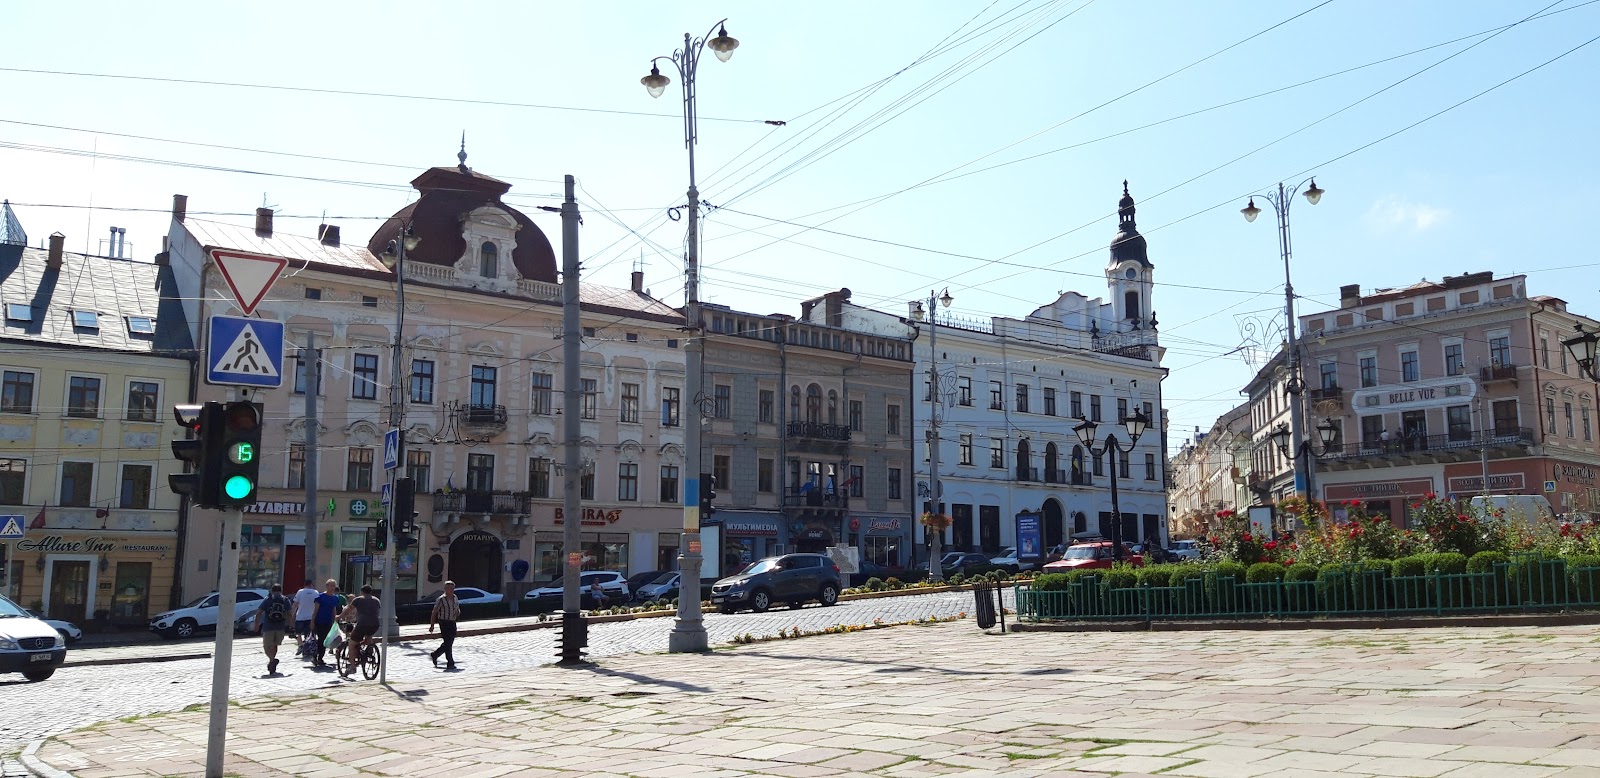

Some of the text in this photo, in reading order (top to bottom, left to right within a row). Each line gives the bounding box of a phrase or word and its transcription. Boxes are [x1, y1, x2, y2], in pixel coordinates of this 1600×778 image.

[1389, 388, 1436, 404] BELLE VUE
[237, 444, 252, 461] 15
[554, 507, 606, 521] BiRA
[17, 535, 82, 552] Allure
[85, 536, 117, 552] Inn
[463, 534, 495, 542] НОТАРІУС
